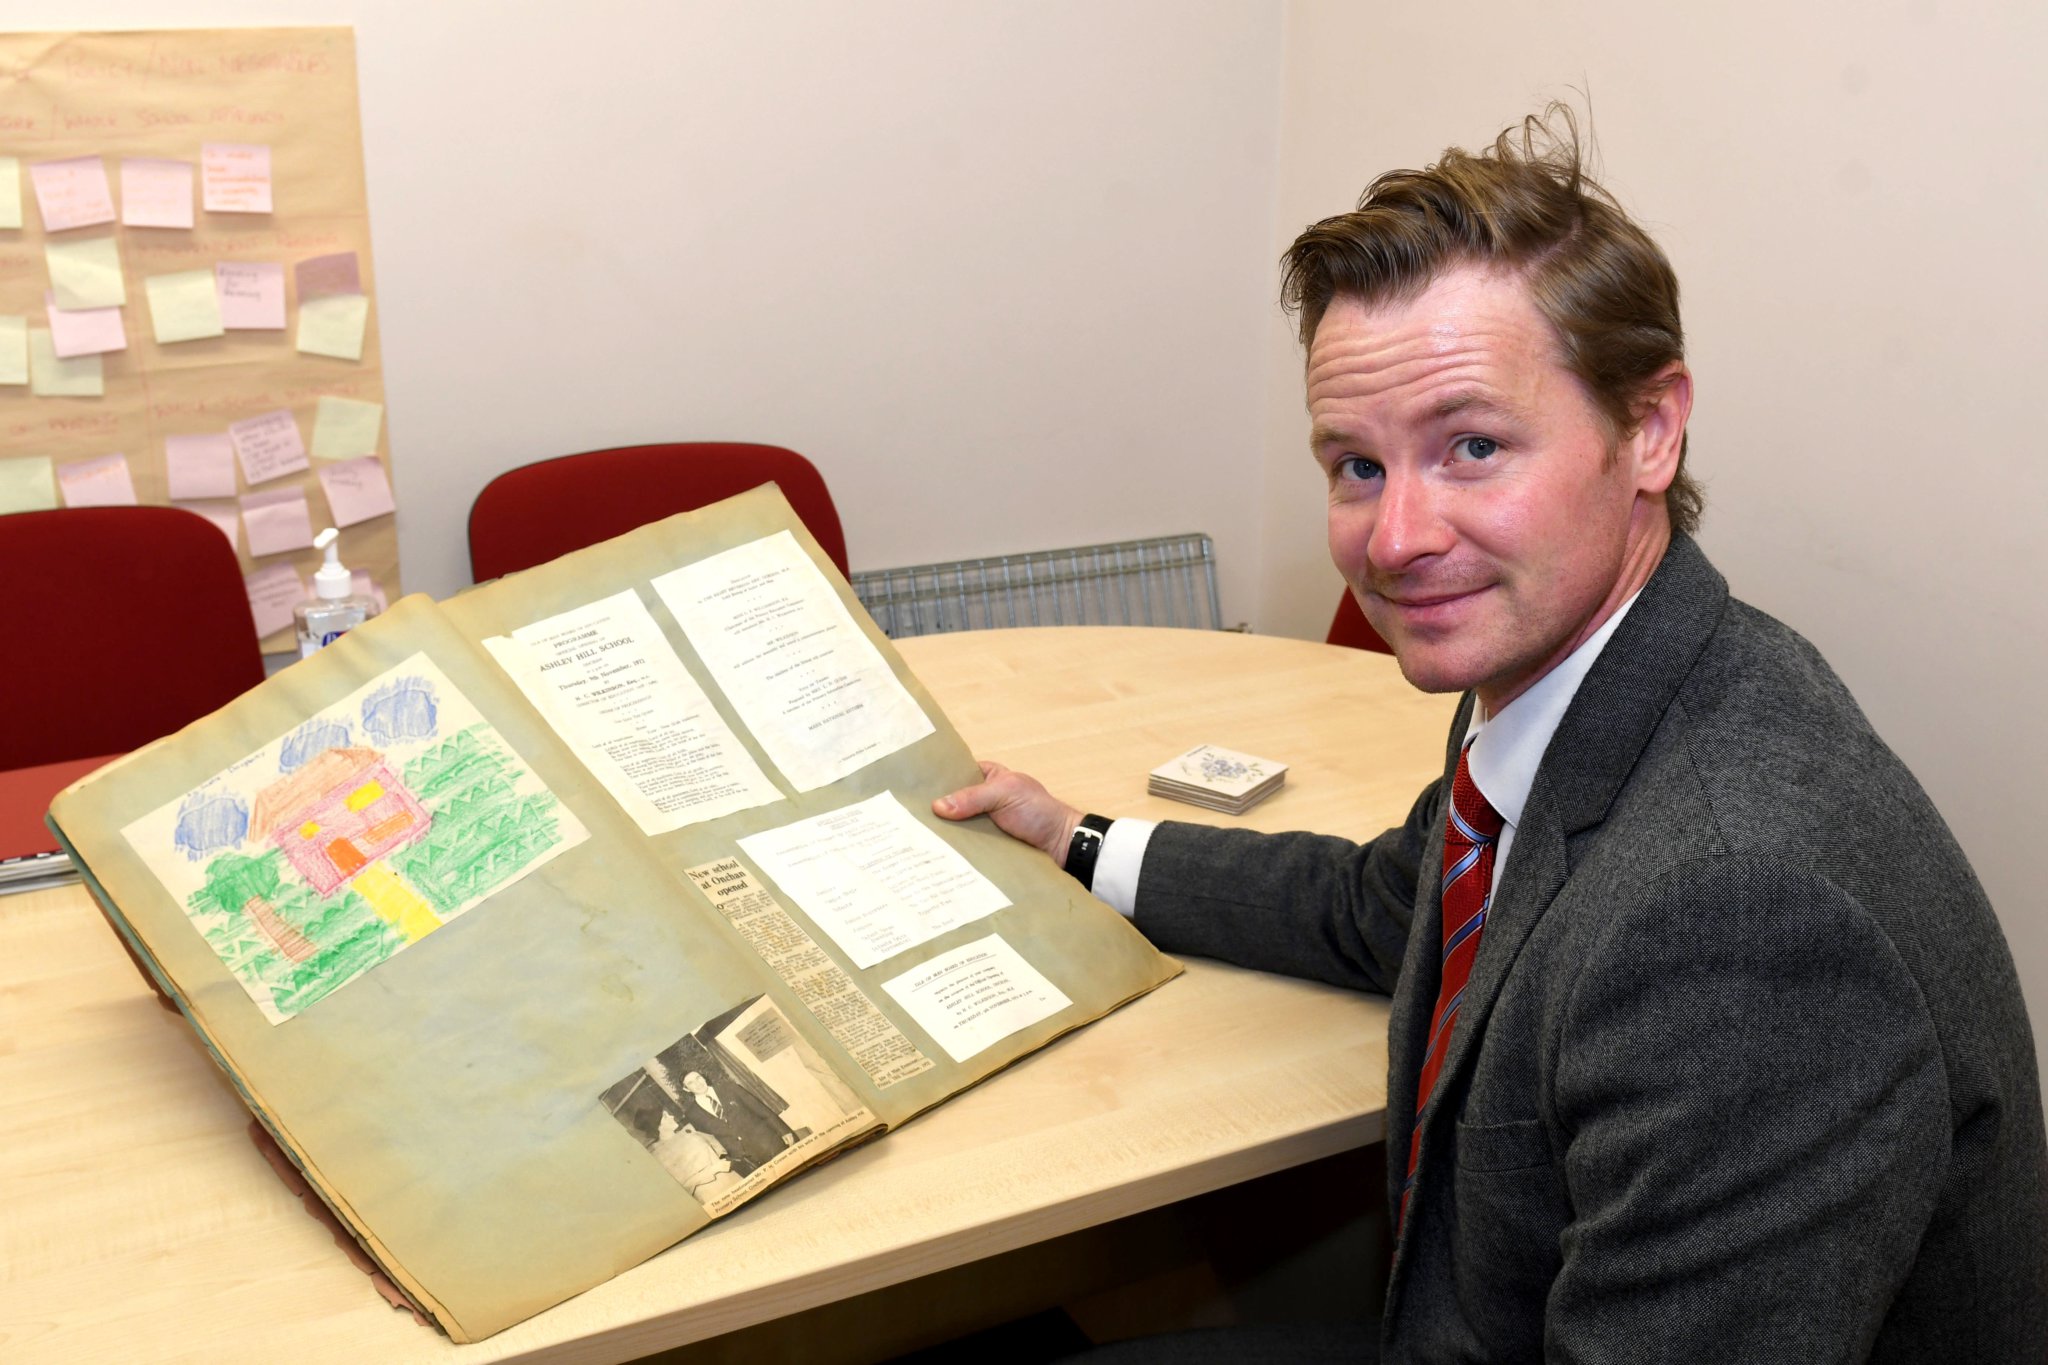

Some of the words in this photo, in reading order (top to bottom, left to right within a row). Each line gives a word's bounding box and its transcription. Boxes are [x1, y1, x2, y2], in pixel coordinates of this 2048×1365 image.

[552, 629, 598, 648] PROGRAMME
[539, 656, 573, 672] ASHLEY
[575, 648, 597, 660] HILL
[598, 636, 634, 652] SCHOOL
[557, 679, 586, 691] Thursday,
[599, 663, 632, 678] November,
[590, 683, 625, 696] WILKINSON,
[687, 870, 711, 881] New
[711, 860, 740, 874] school
[700, 881, 711, 890] at
[711, 870, 747, 886] Onchan
[716, 880, 749, 897] opened
[714, 1200, 732, 1212] Primary
